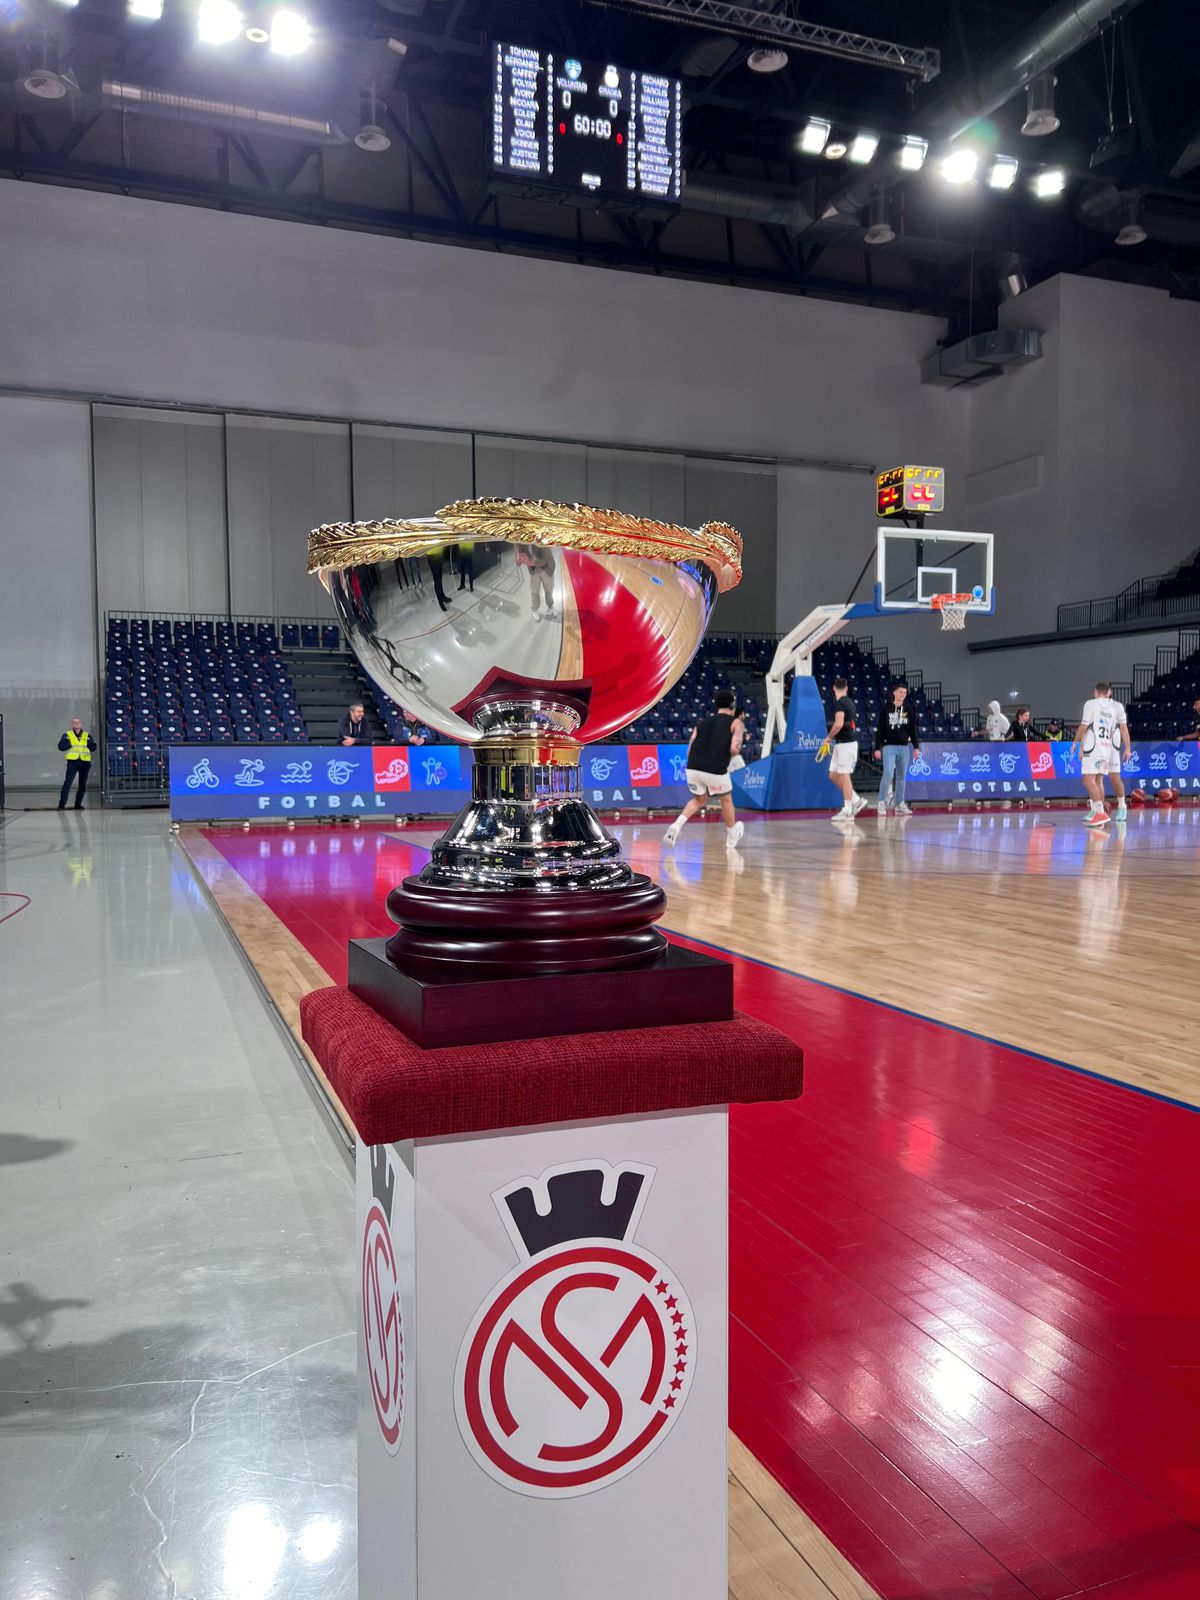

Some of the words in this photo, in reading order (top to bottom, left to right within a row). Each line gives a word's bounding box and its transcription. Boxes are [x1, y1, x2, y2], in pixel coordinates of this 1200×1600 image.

[563, 90, 571, 109] 0
[610, 100, 618, 118] 0
[574, 114, 611, 139] 60:00
[512, 148, 538, 160] JUSTICE
[958, 780, 1041, 793] FOTBAL
[258, 794, 386, 809] FOTBAL
